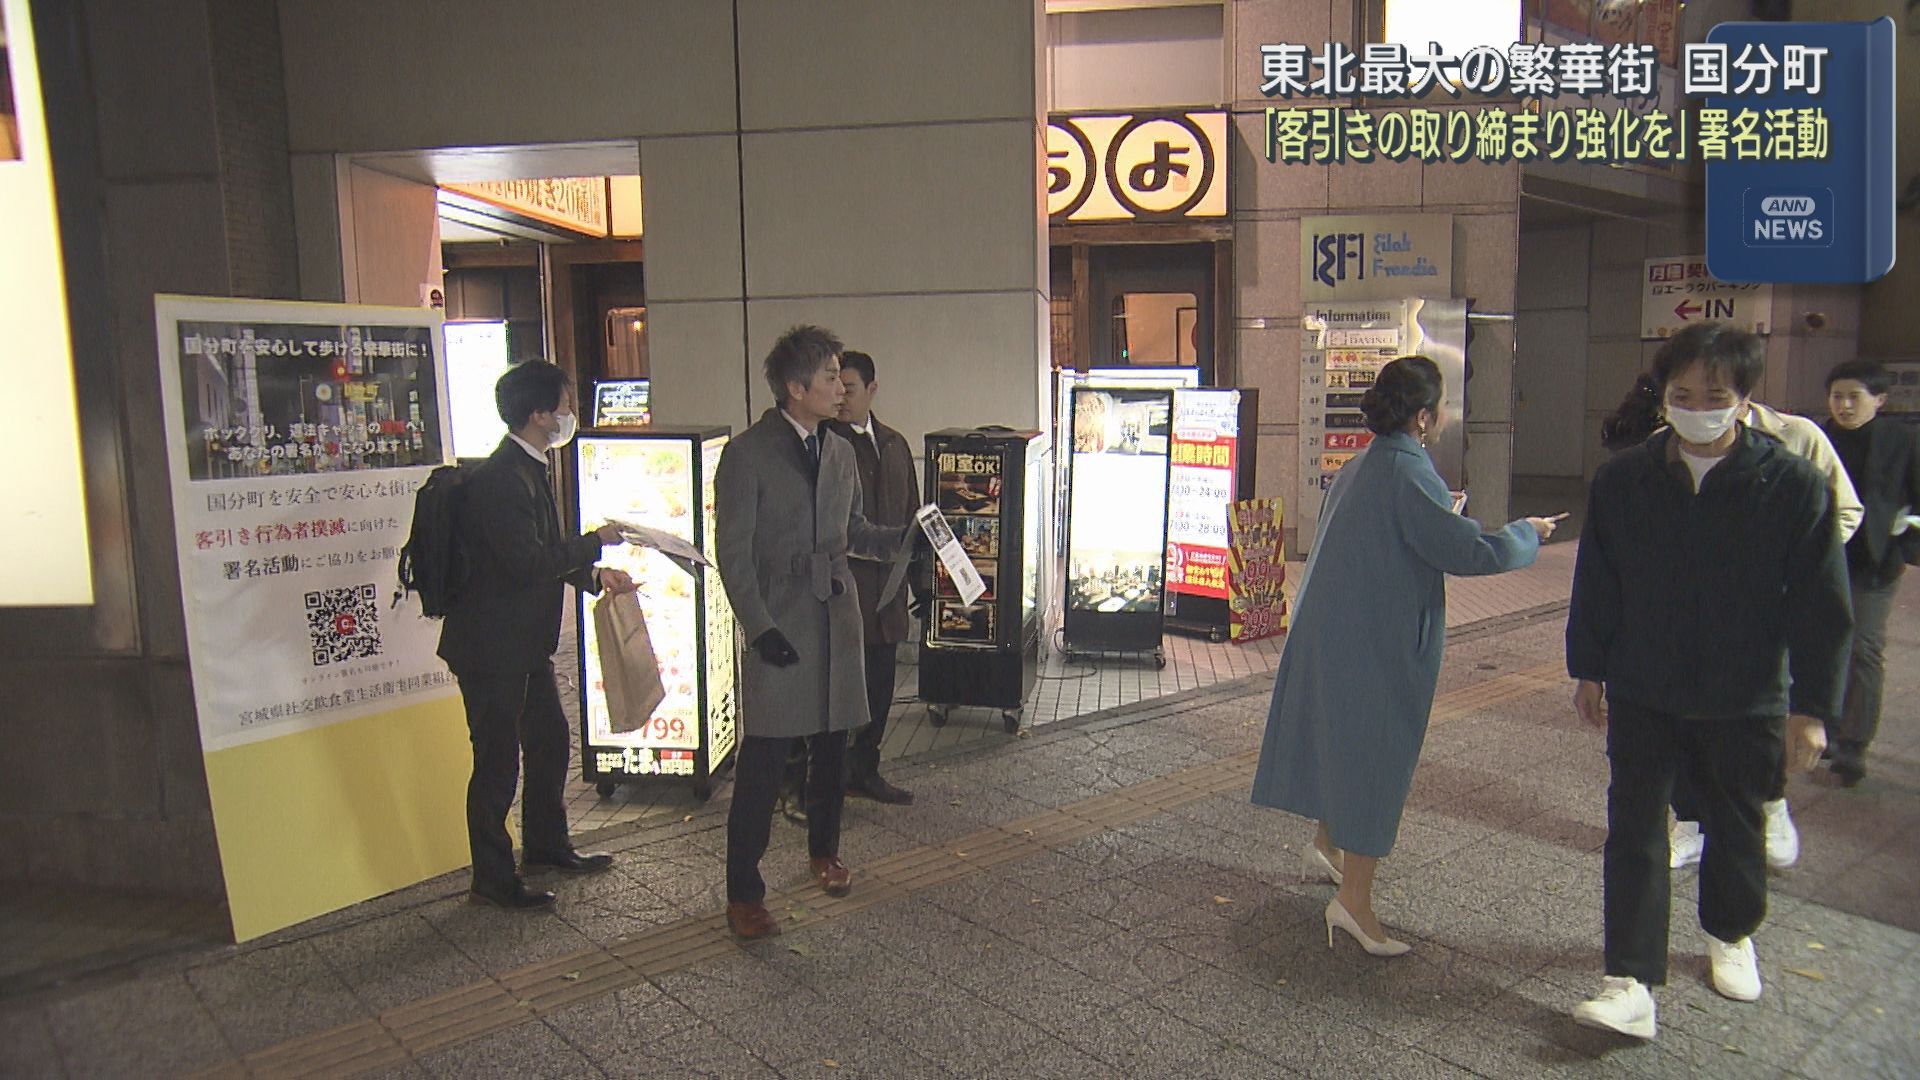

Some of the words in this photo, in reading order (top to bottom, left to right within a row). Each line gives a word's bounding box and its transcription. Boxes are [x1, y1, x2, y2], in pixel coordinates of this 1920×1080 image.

[1316, 310, 1391, 322] Information
[1705, 298, 1734, 318] IN
[195, 517, 400, 550] 客引き行為者撲滅に向けた
